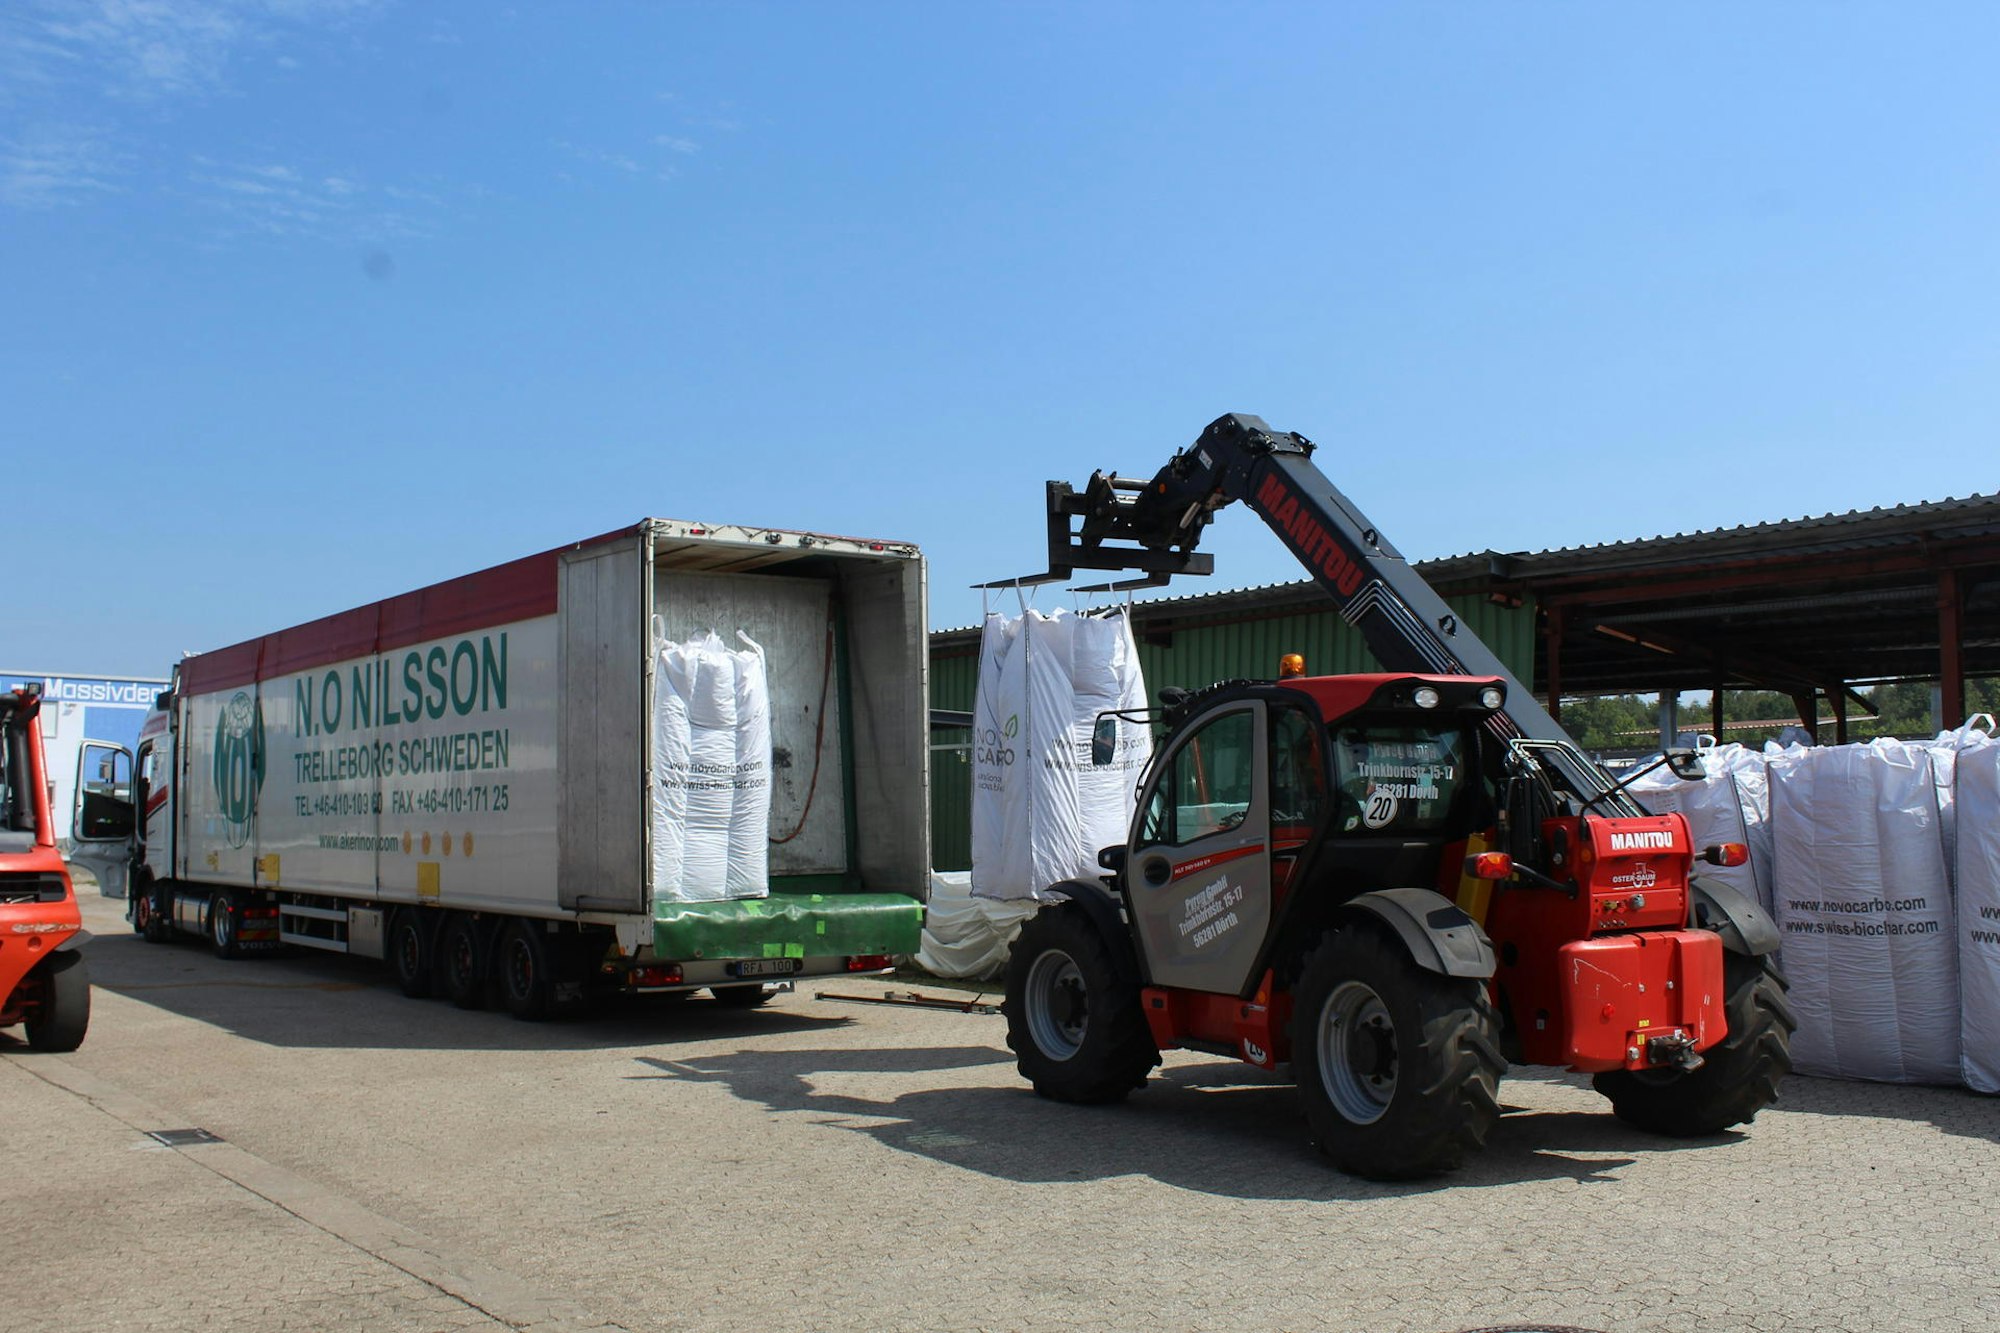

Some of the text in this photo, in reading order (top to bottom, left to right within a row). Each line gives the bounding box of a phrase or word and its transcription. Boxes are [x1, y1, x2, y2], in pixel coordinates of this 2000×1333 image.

[1257, 473, 1365, 597] MANITOU
[45, 679, 172, 702] Massivdec
[296, 632, 508, 738] N.O NILSSON
[295, 728, 509, 784] TRELLEBORG SCHWEDEN
[392, 789, 414, 814] FAX
[417, 786, 489, 814] +46-410-171
[493, 785, 509, 811] 25
[1368, 796, 1392, 821] 20
[1611, 831, 1674, 850] MANITOU
[1222, 885, 1243, 908] 15-17
[1788, 897, 1927, 914] www.novocarbo.com
[1193, 924, 1217, 949] 56281
[1786, 920, 1939, 937] www.swiss-biochar.com
[743, 959, 792, 975] RFA 100
